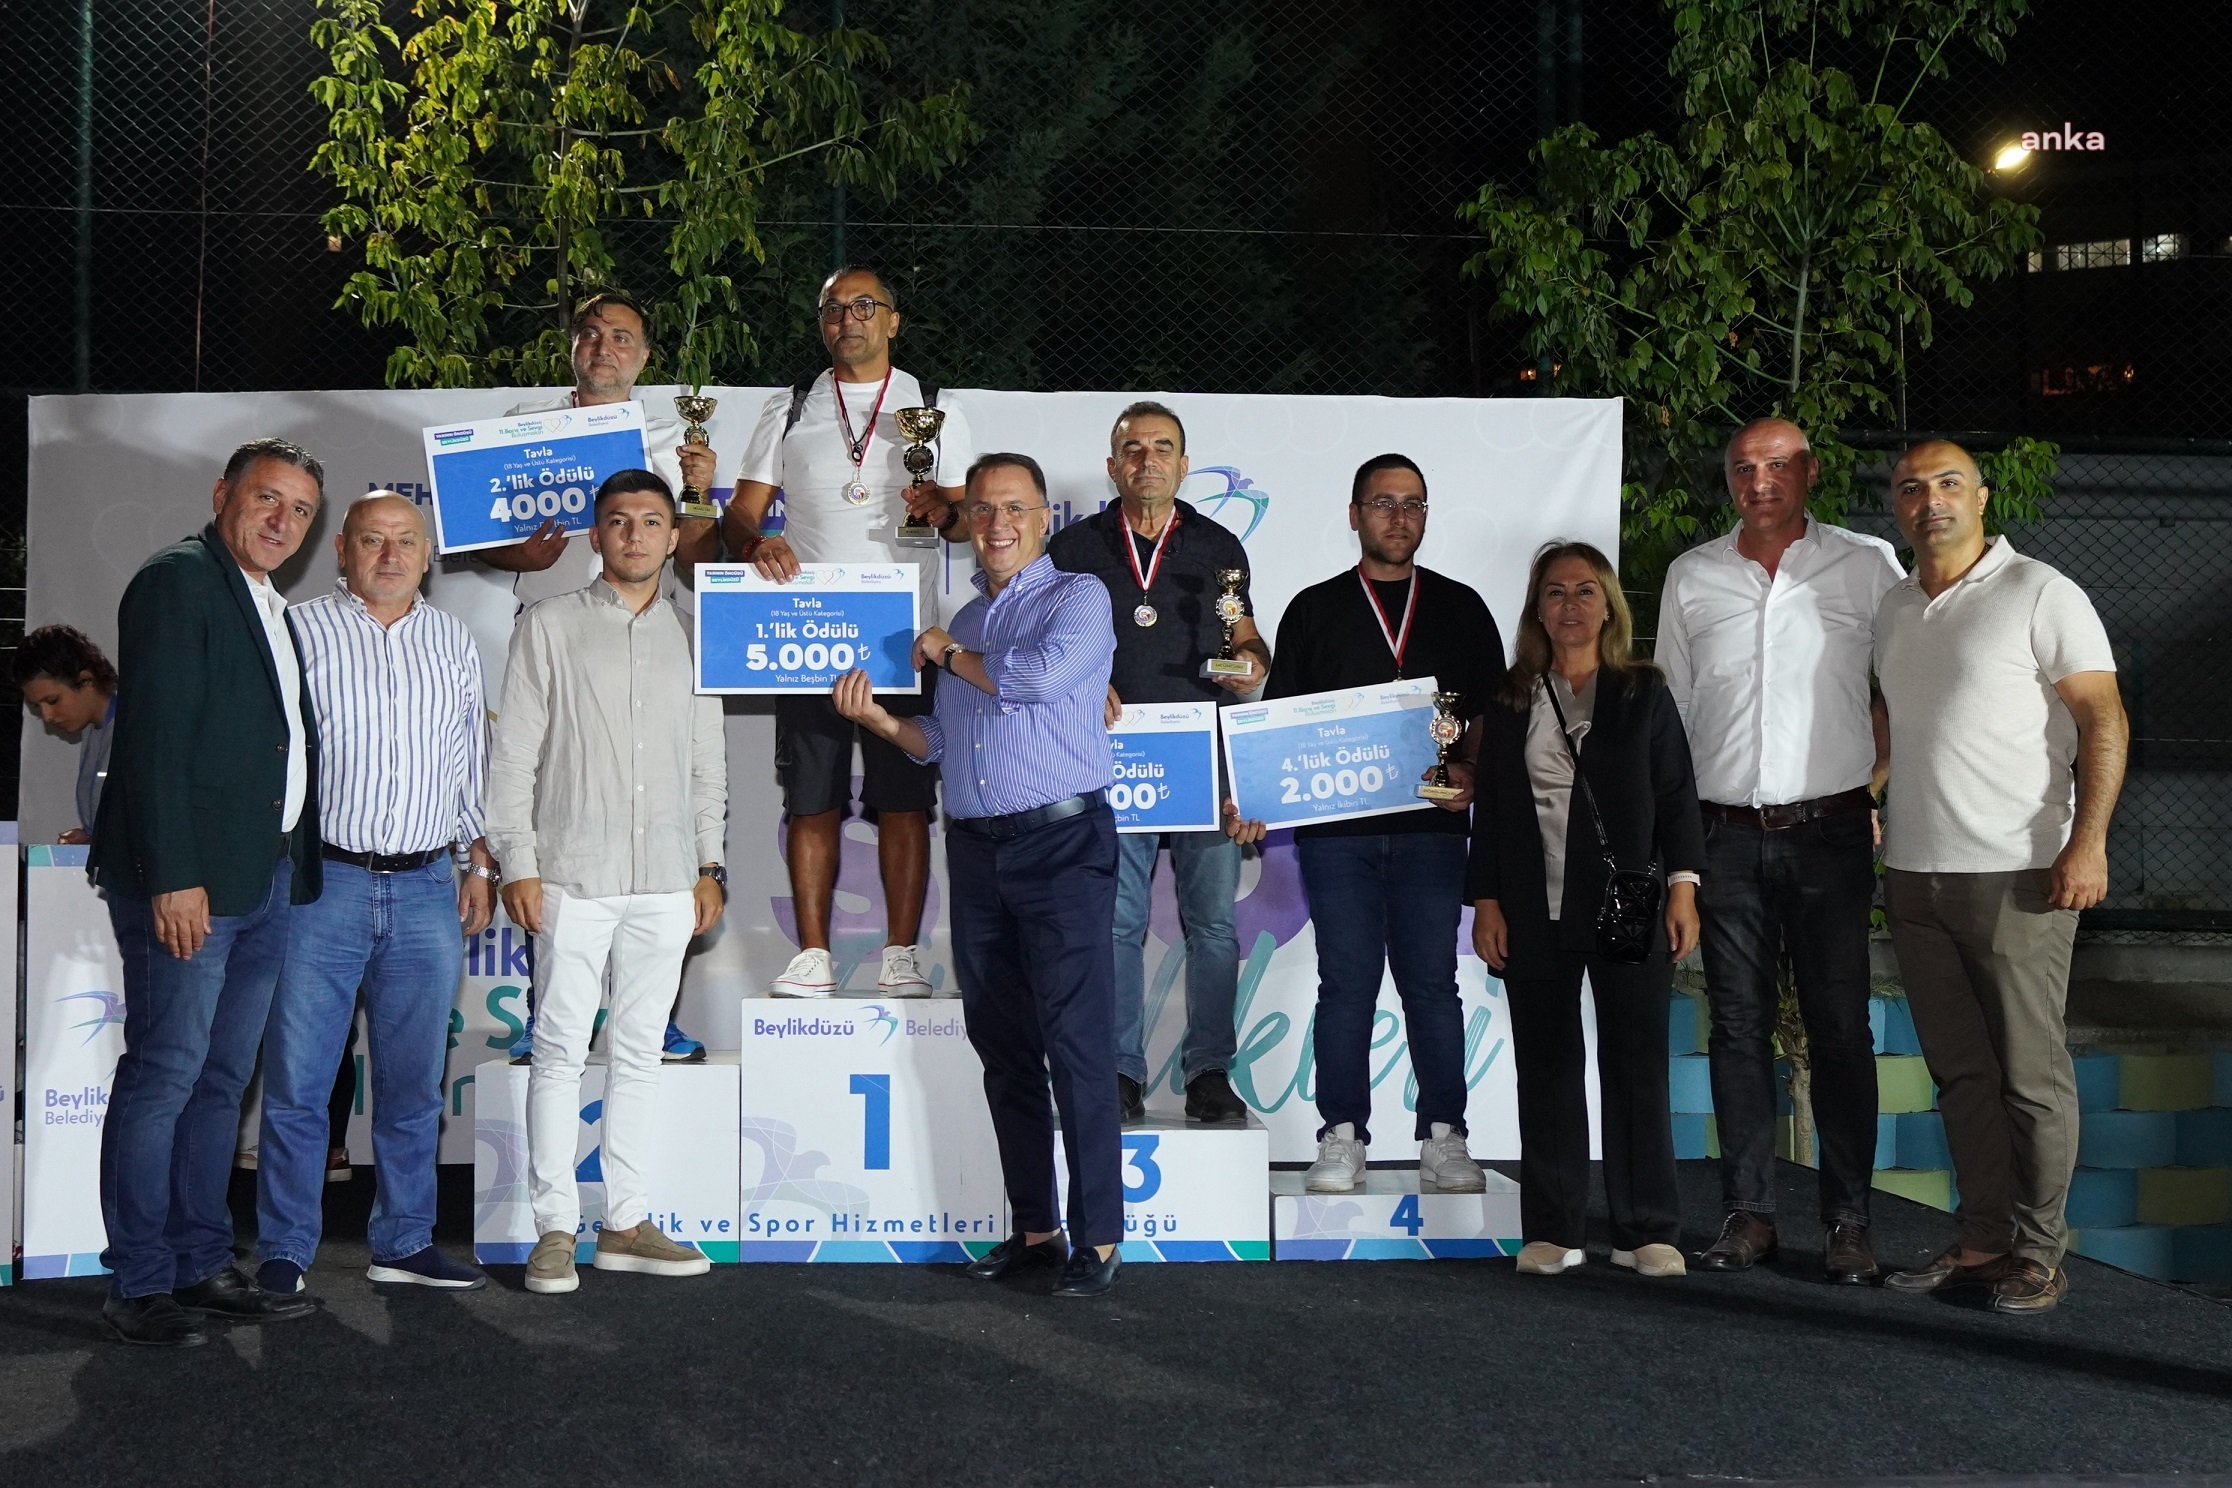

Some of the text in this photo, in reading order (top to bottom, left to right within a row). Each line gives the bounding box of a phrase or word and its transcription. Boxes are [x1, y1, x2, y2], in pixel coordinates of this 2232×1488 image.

[524, 446, 553, 459] Tavla
[538, 466, 595, 486] Ödülü
[792, 597, 822, 608] Tavla
[780, 610, 790, 618] Yaş
[814, 610, 844, 618] Kategorisi)
[802, 620, 859, 638] Ödülü
[776, 674, 799, 683] Yalnız
[801, 674, 828, 684] Beşbin
[1318, 725, 1346, 738] Tavla
[1335, 744, 1390, 765] Ödülü
[1112, 761, 1164, 779] Ödülü
[1312, 802, 1336, 812] Yalnız
[1360, 798, 1370, 806] TL
[1131, 814, 1140, 822] TL
[754, 1018, 968, 1041] Beylikdüzü Belediy
[45, 1086, 108, 1110] Beylik
[45, 1109, 105, 1128] Belediy
[850, 1074, 890, 1170] 1
[1121, 1134, 1162, 1203] 3
[1390, 1194, 1423, 1236] 4
[700, 1219, 731, 1233] ve
[749, 1212, 815, 1237] Spor
[832, 1212, 994, 1233] Hizmetleri
